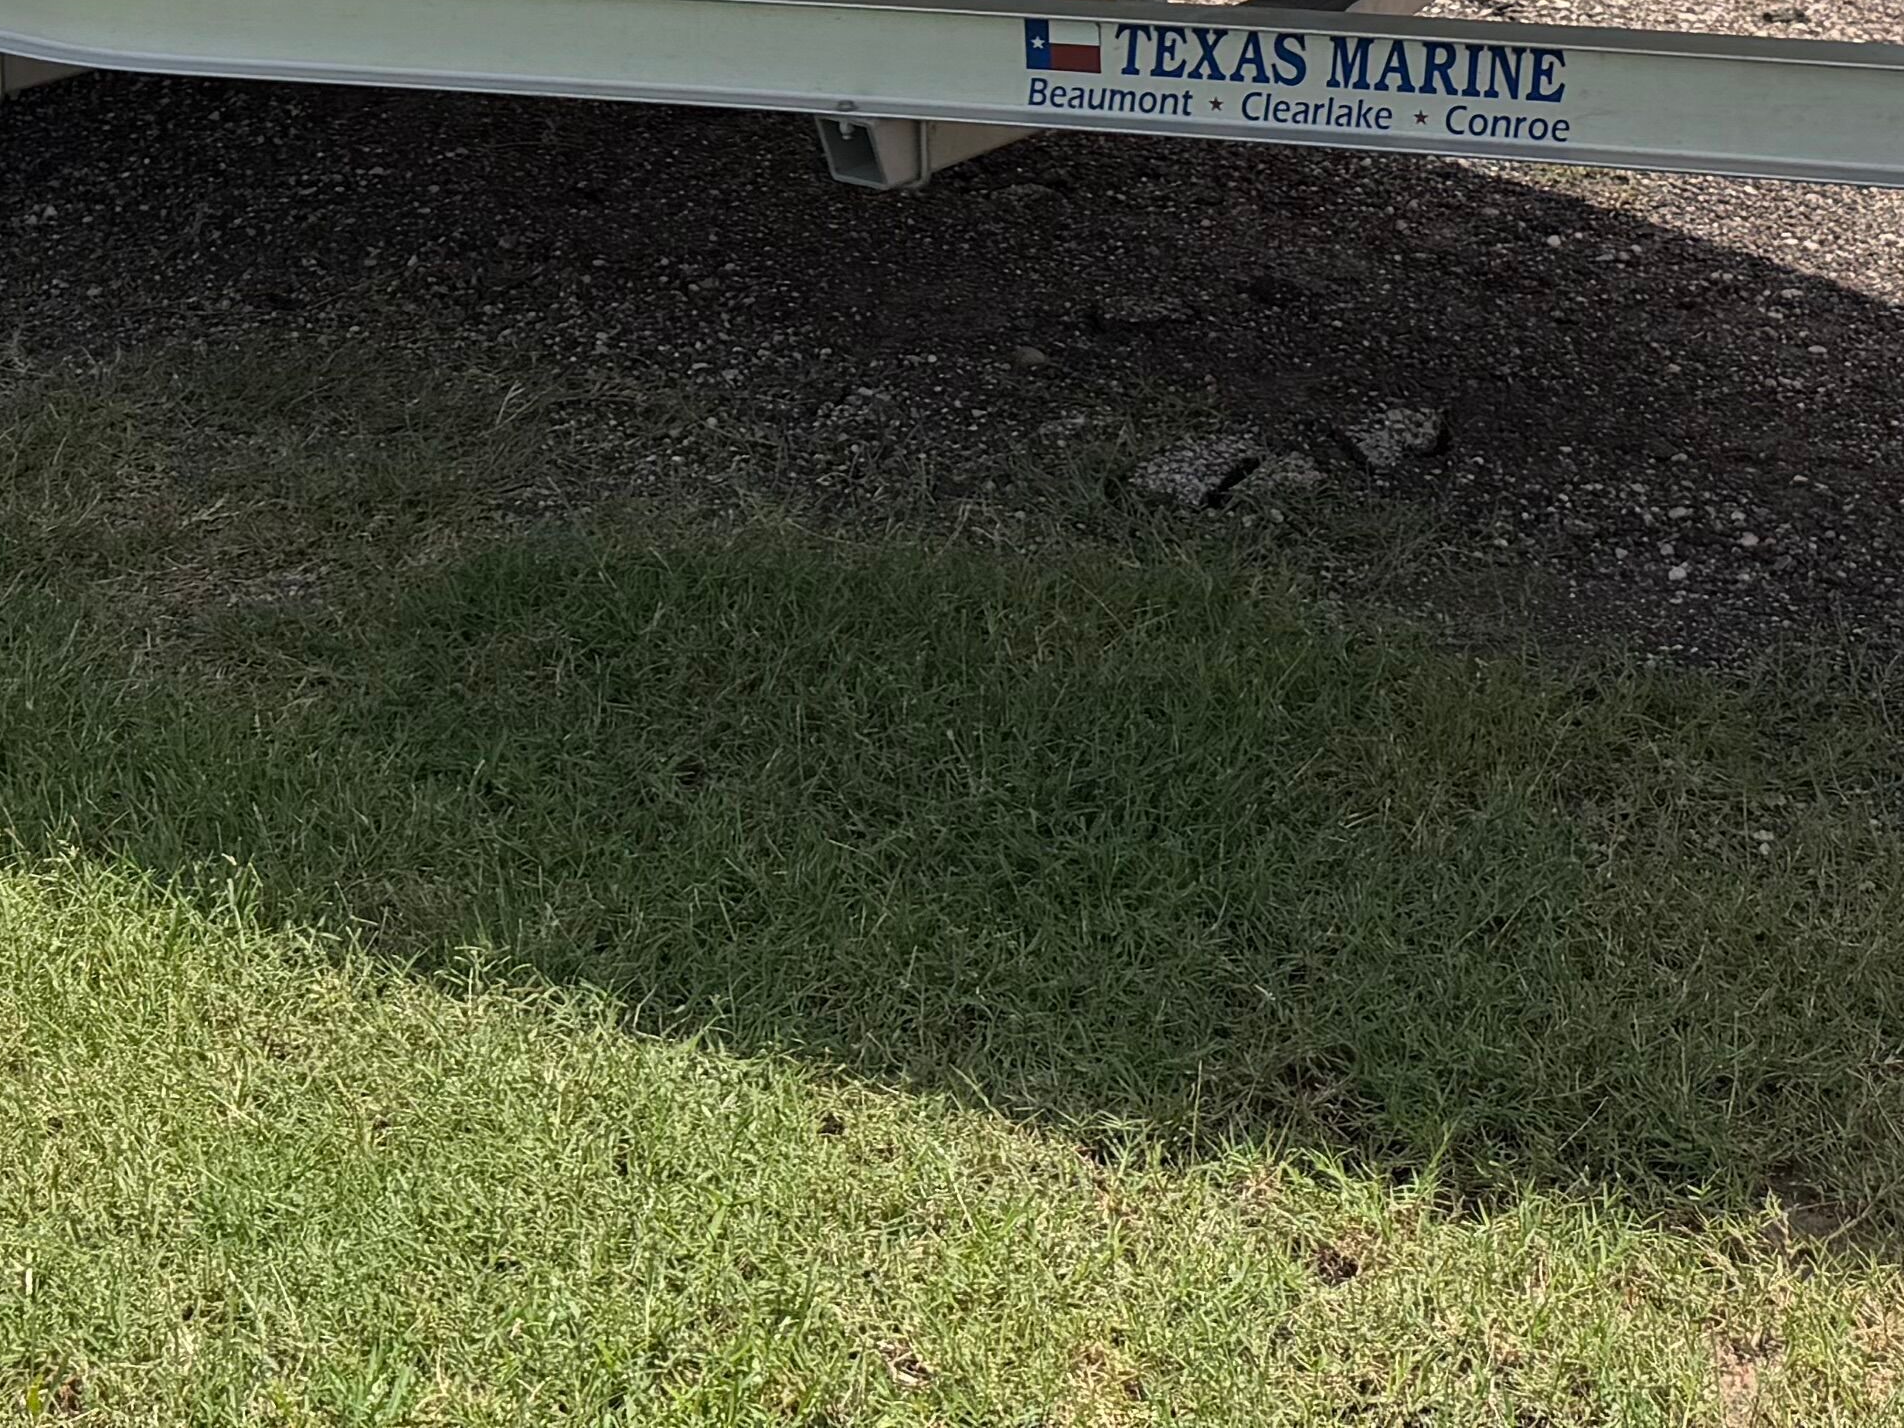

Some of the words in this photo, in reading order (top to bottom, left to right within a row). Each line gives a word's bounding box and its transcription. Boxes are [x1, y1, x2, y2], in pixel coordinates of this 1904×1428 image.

[1115, 22, 1307, 87] TEXAS
[1326, 35, 1567, 103] MARINE
[1028, 77, 1193, 117] Beaumont
[1241, 91, 1393, 131] Clearlake
[1445, 104, 1571, 143] Conroe
